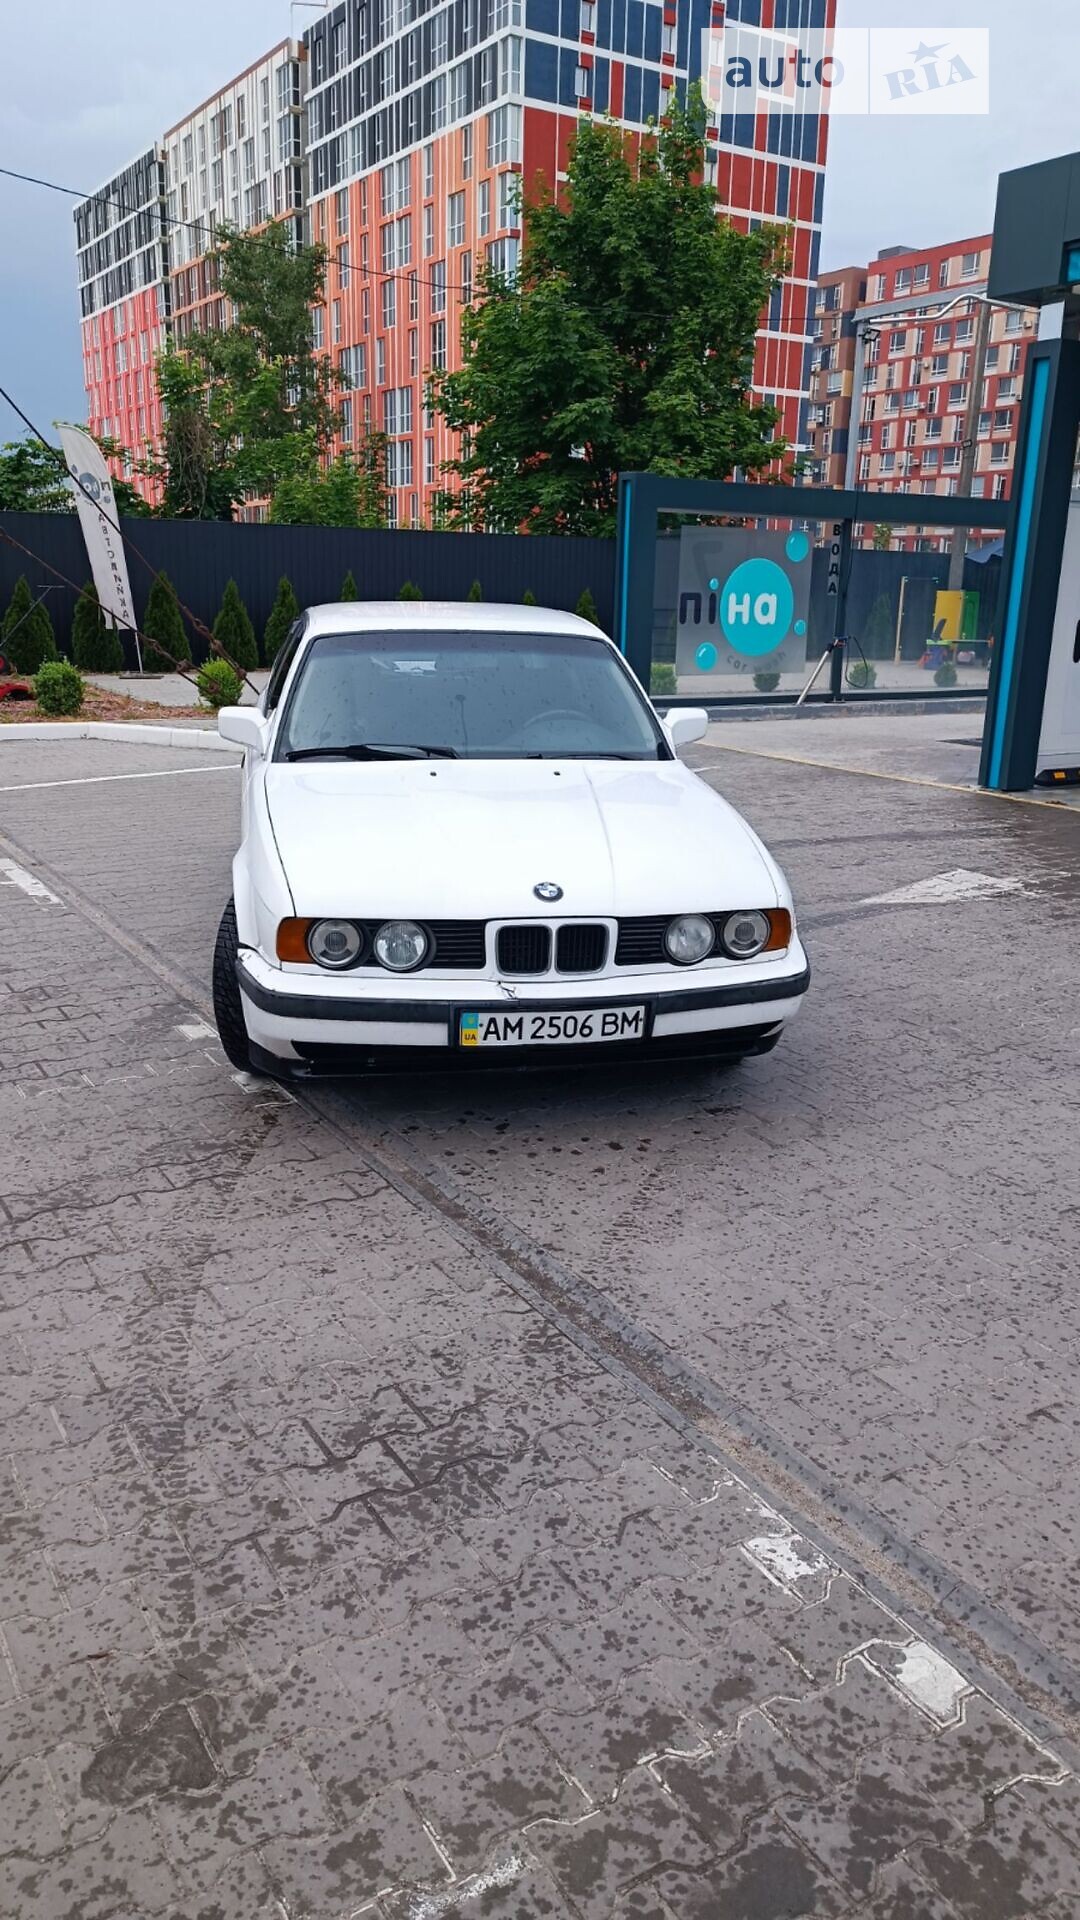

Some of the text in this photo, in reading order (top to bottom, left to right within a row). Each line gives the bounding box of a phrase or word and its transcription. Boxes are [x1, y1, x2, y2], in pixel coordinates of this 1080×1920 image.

[827, 523, 842, 595] ВОДА
[679, 577, 778, 625] піна
[464, 1033, 477, 1042] UA
[482, 1010, 641, 1041] AM 2506 BM
